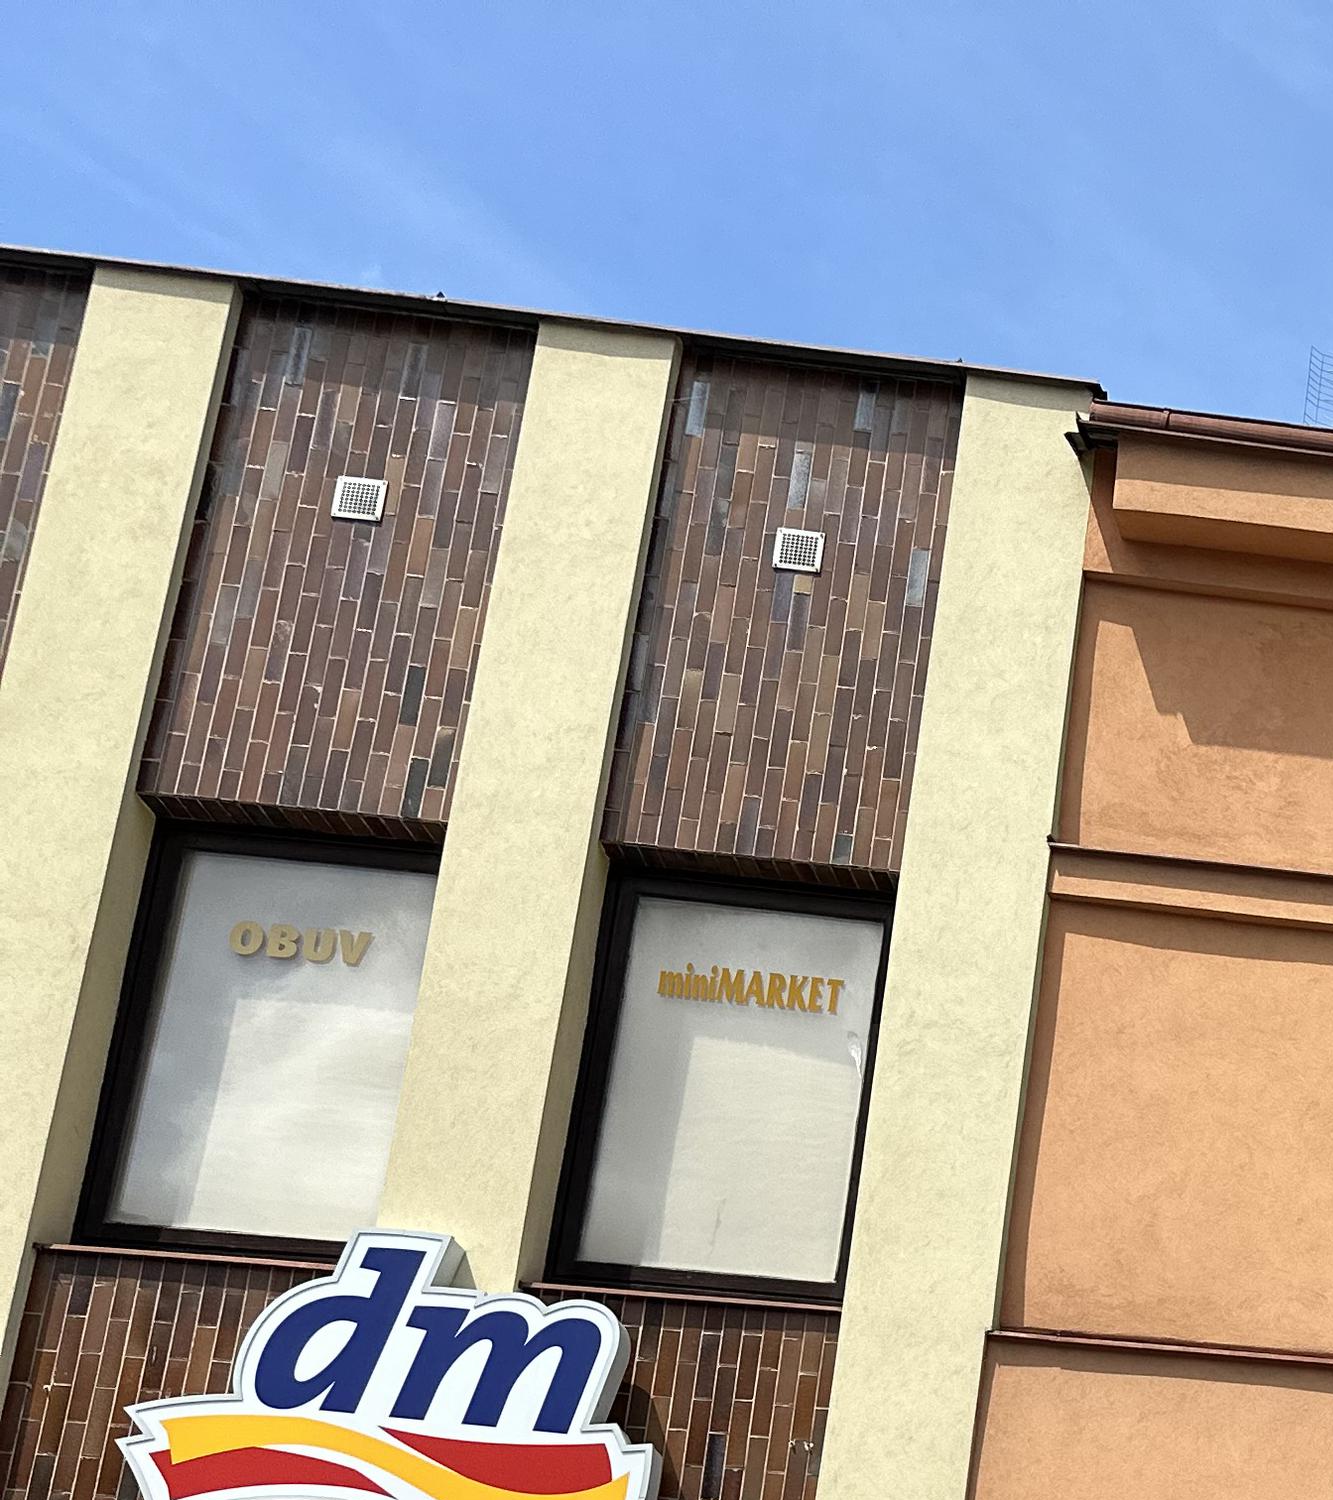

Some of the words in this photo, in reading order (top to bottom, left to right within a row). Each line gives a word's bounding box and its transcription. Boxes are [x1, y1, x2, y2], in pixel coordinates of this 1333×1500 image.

[228, 920, 374, 967] OBUV
[656, 963, 845, 1016] miniMARKET
[255, 1246, 603, 1433] dm
